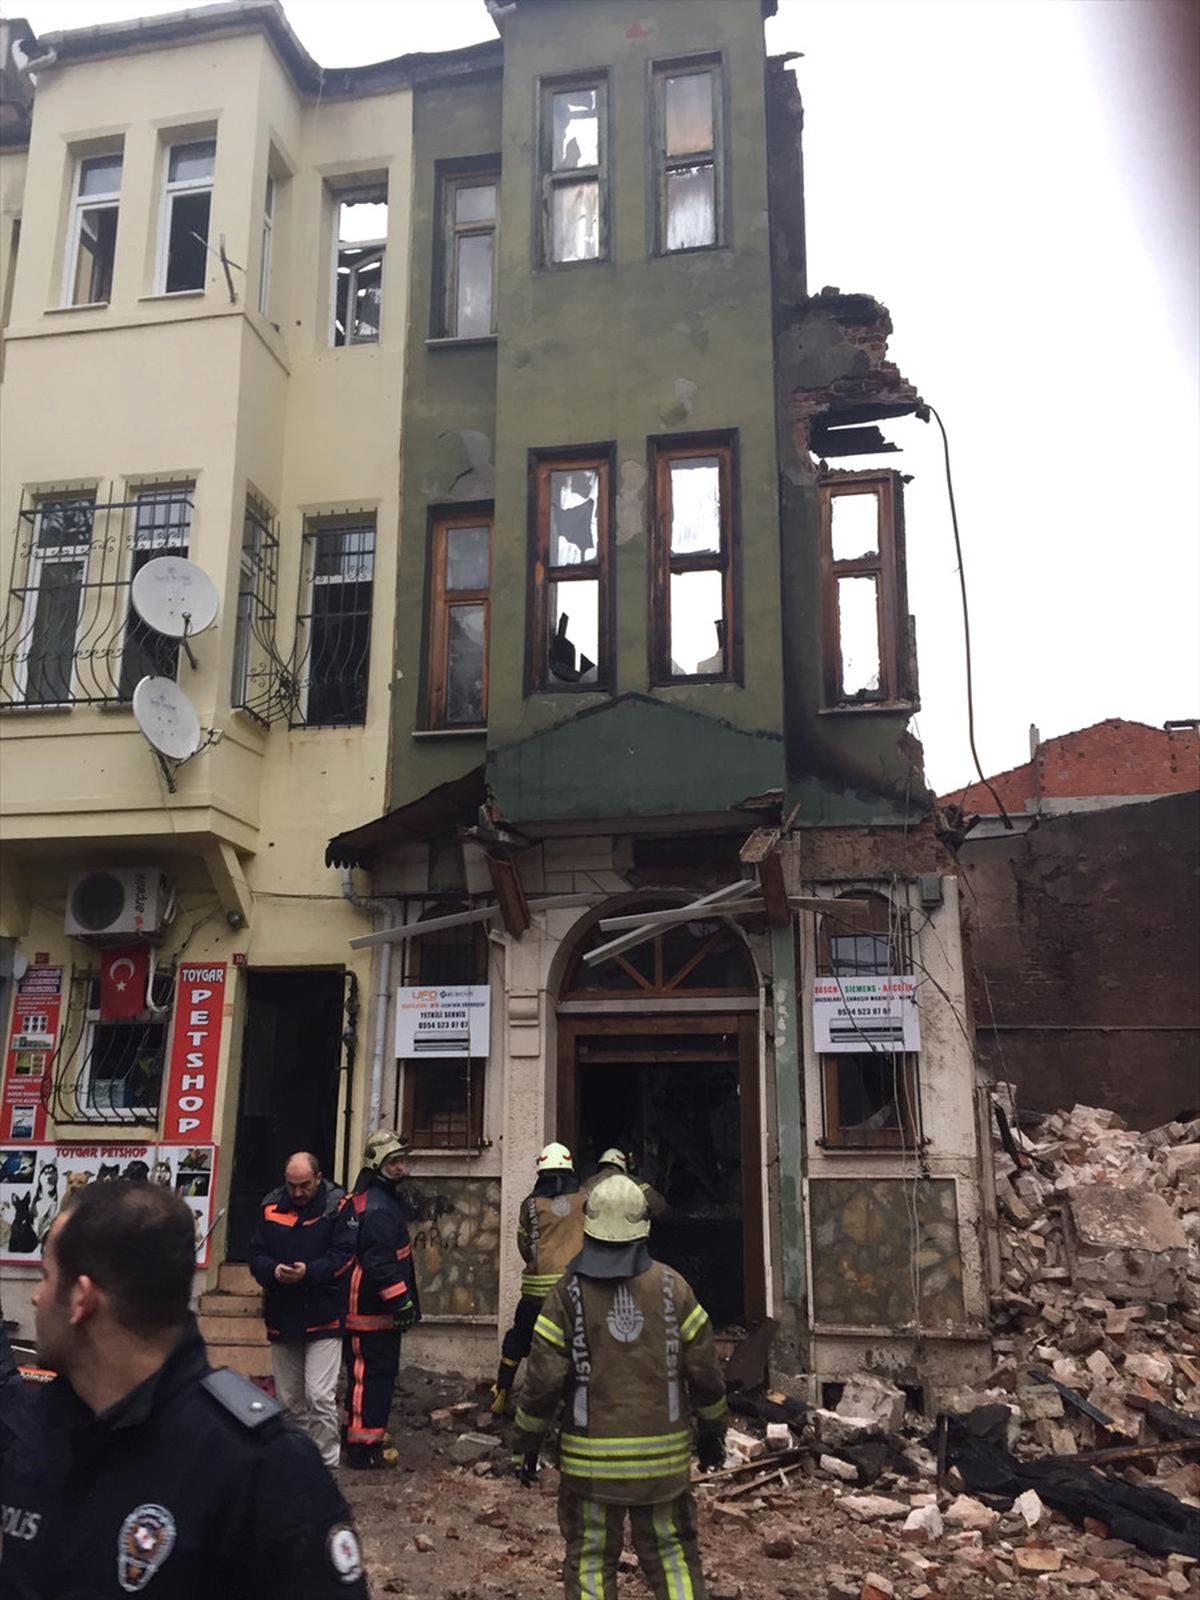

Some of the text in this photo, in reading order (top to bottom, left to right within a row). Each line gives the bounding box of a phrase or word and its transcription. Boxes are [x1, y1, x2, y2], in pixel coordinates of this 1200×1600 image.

[182, 969, 224, 983] TOYGAR
[412, 989, 437, 999] UFO
[845, 985, 876, 993] SIEMENS
[444, 1010, 466, 1018] SERVİS
[177, 989, 212, 1134] PETSHOP
[55, 1147, 148, 1158] TOYGAR PETSHOP
